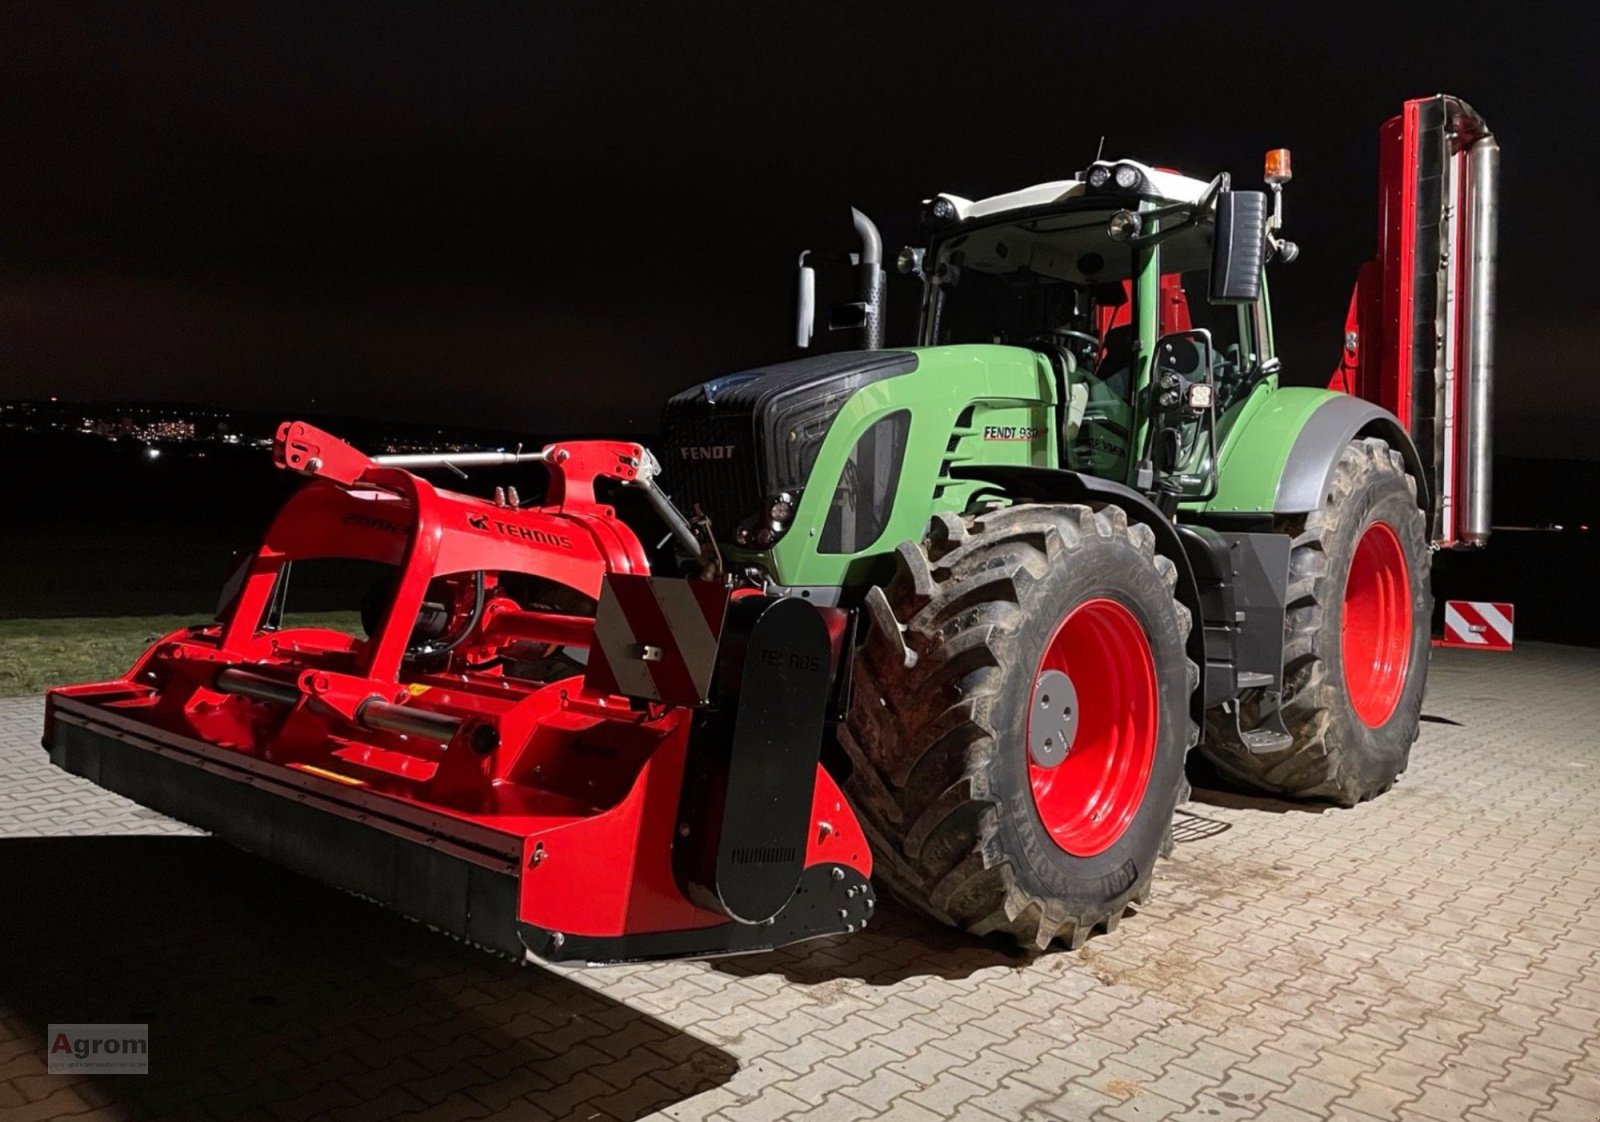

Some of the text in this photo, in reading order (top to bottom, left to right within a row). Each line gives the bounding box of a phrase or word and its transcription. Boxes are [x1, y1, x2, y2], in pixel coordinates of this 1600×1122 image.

[985, 426, 1016, 439] FENDT
[681, 445, 736, 460] FENDT
[494, 521, 574, 549] TEHNOS
